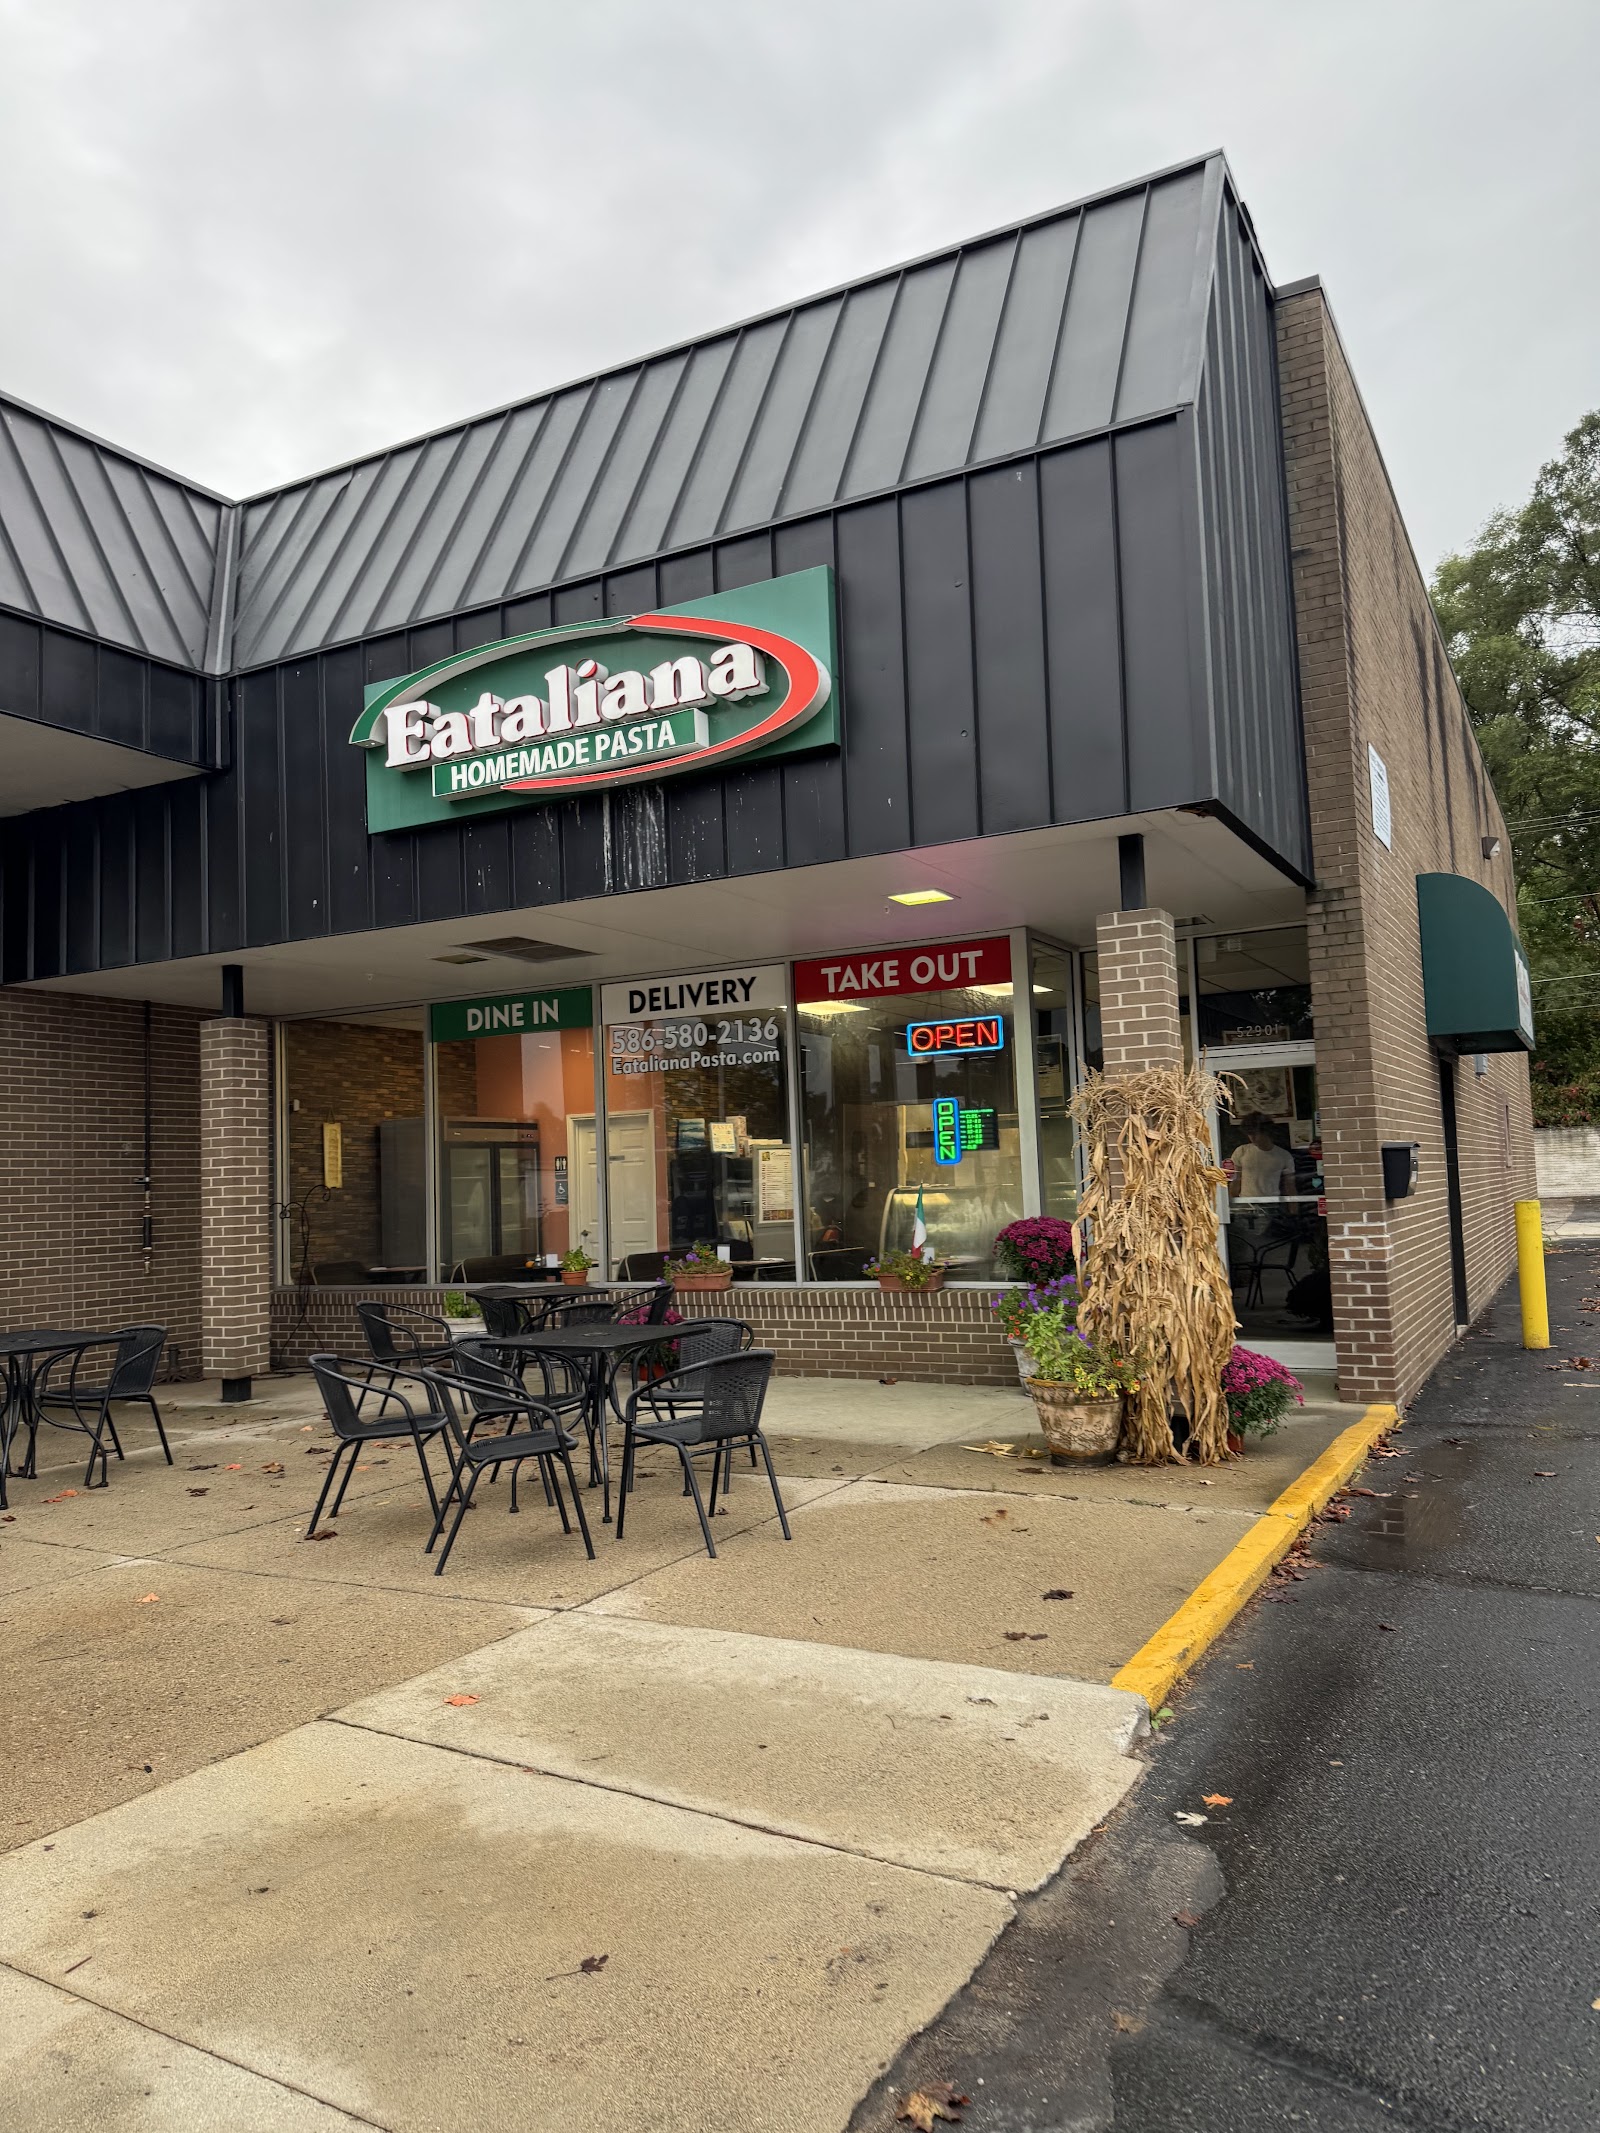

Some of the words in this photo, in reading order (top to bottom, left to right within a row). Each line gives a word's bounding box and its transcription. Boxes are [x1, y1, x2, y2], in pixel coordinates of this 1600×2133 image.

[383, 643, 764, 768] Eataliana
[450, 736, 589, 791] HOMEMADE
[600, 720, 677, 761] PASTA
[821, 960, 900, 993] TAKE
[910, 950, 983, 984] OUT
[629, 976, 757, 1014] DELIVERY
[466, 1002, 525, 1032] DINE
[532, 998, 560, 1025] IN
[1236, 1024, 1279, 1038] 52901
[611, 1016, 779, 1055] 586-580-2136
[911, 1021, 999, 1050] OPEN
[611, 1050, 781, 1075] EatalianaPasta.com
[938, 1102, 956, 1160] OPEN
